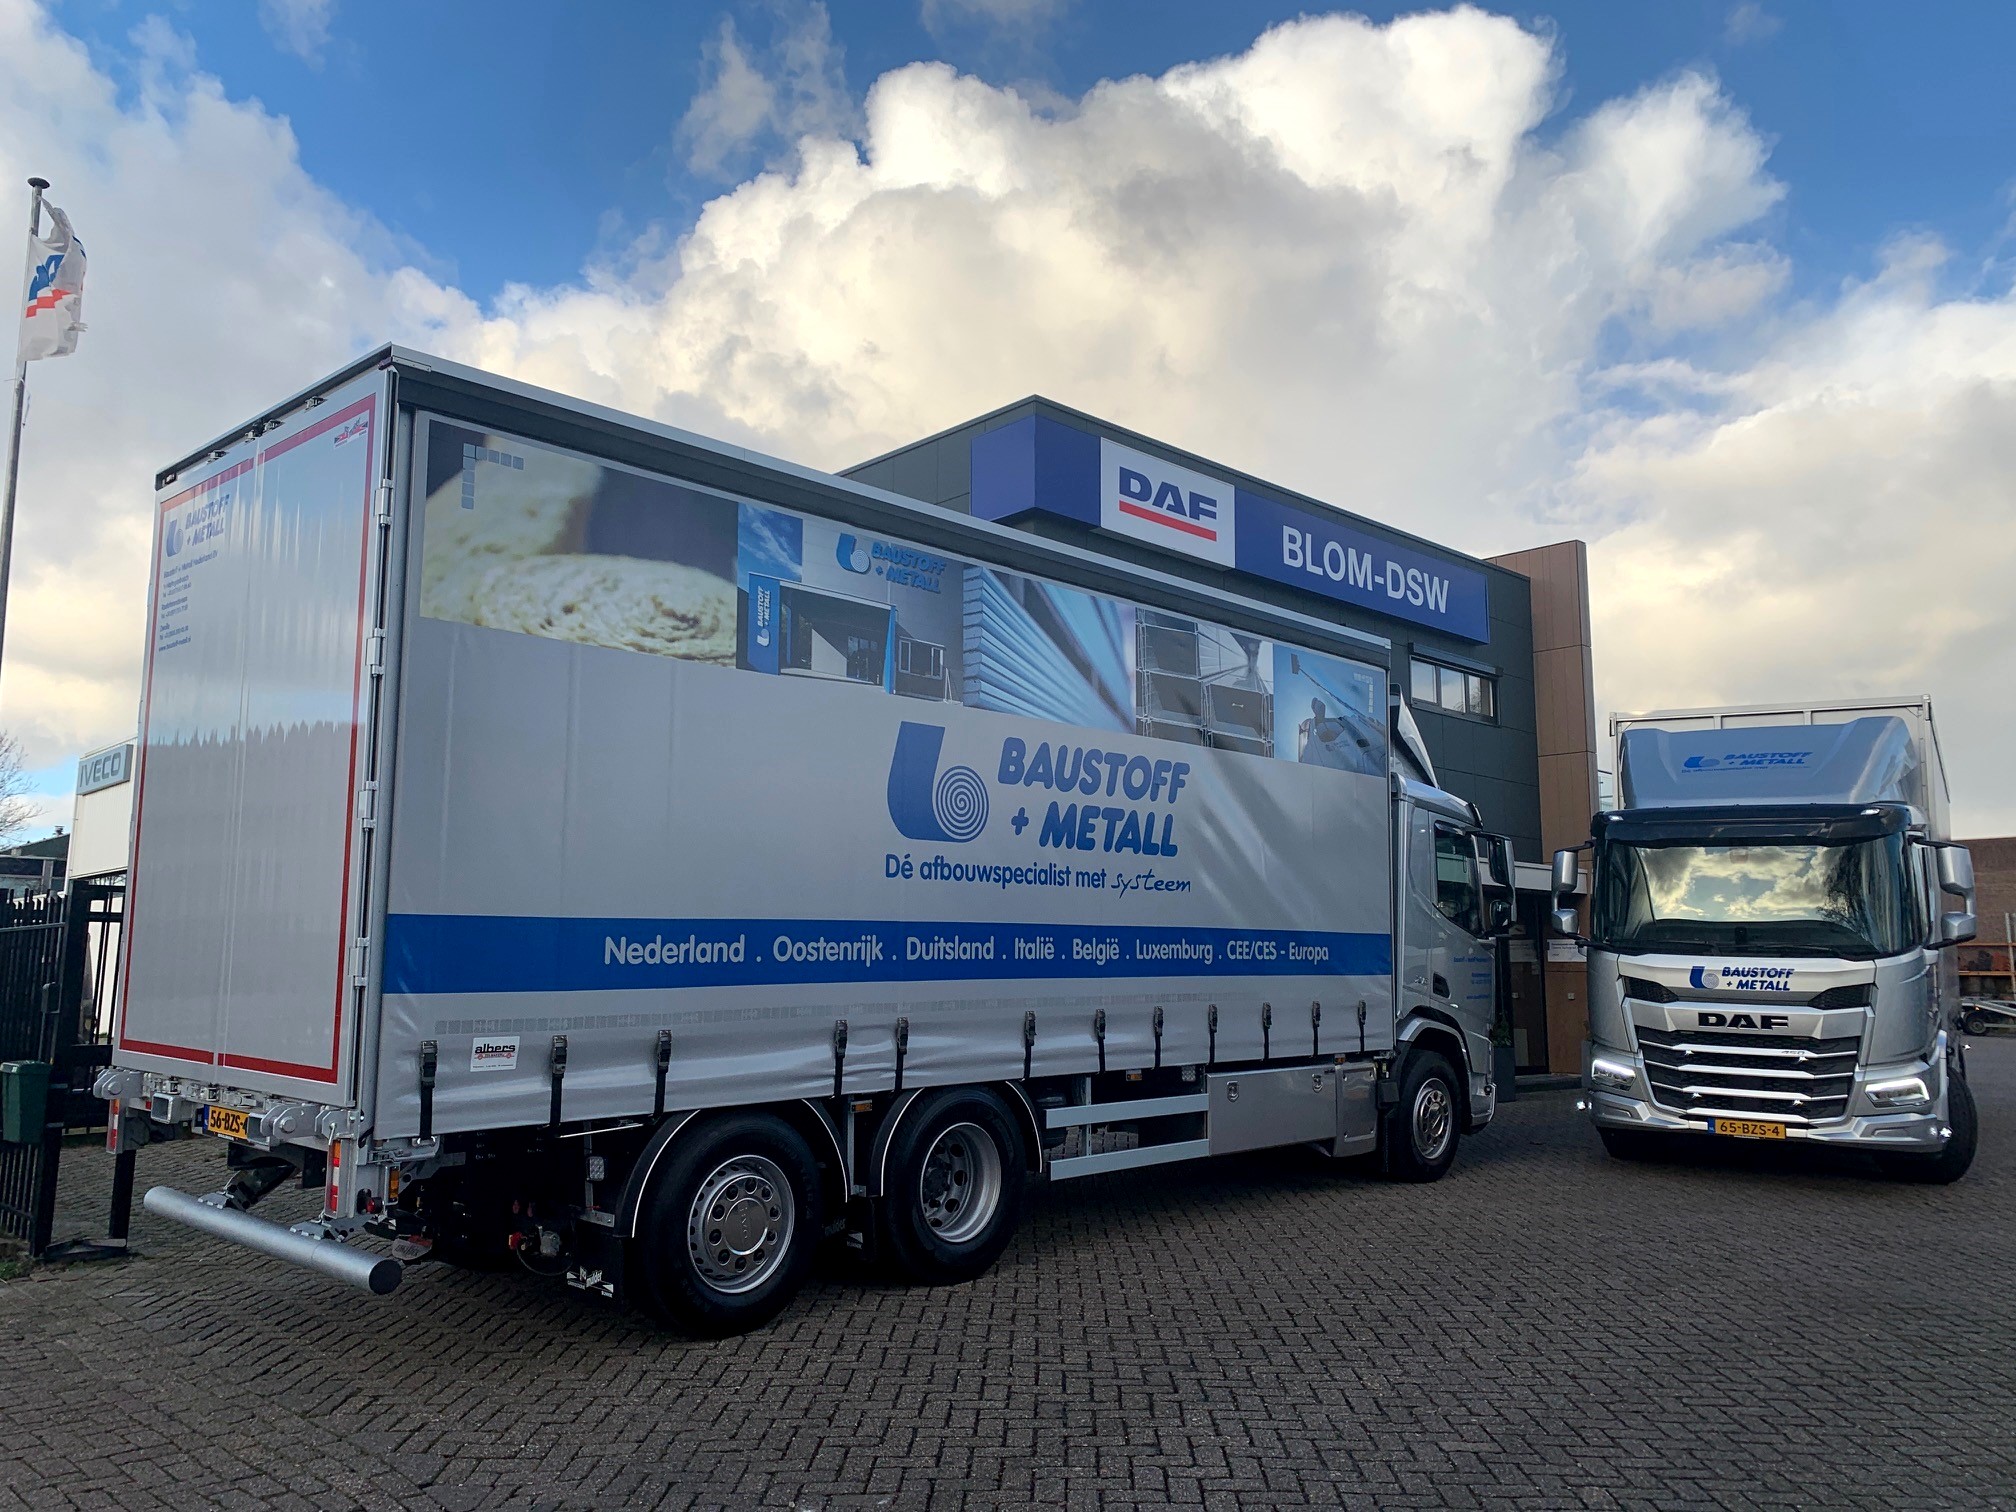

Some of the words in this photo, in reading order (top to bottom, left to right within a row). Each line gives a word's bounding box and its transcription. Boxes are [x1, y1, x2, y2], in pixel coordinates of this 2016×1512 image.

[1119, 466, 1217, 520] DAF
[192, 516, 224, 546] METALL
[872, 541, 947, 575] BAUSTOFF
[1282, 524, 1449, 614] BLOM-DSW
[886, 565, 942, 595] METALL
[80, 752, 121, 787] IVECO
[997, 737, 1191, 804] BAUSTOFF
[1724, 752, 1813, 760] BAUSTOFF
[1038, 801, 1178, 857] METALL
[885, 853, 914, 879] Dé
[919, 855, 1072, 889] afbouwspecialist
[1075, 868, 1107, 889] met
[1111, 869, 1191, 898] systeem
[604, 934, 745, 965] Nederland
[773, 934, 883, 967] Oostenrijk
[906, 935, 994, 961] Duitsland
[1014, 937, 1055, 960] Italië
[1072, 937, 1120, 965] België
[1136, 938, 1213, 965] Luxemburg
[1226, 940, 1277, 961] CEE/CES
[1289, 941, 1329, 965] Europa
[1721, 966, 1795, 978] BAUSTOFF
[1736, 979, 1791, 991] METALL
[1698, 1012, 1788, 1030] DAF
[475, 1043, 516, 1053] albers
[1720, 1121, 1780, 1136] 65-BZS-4
